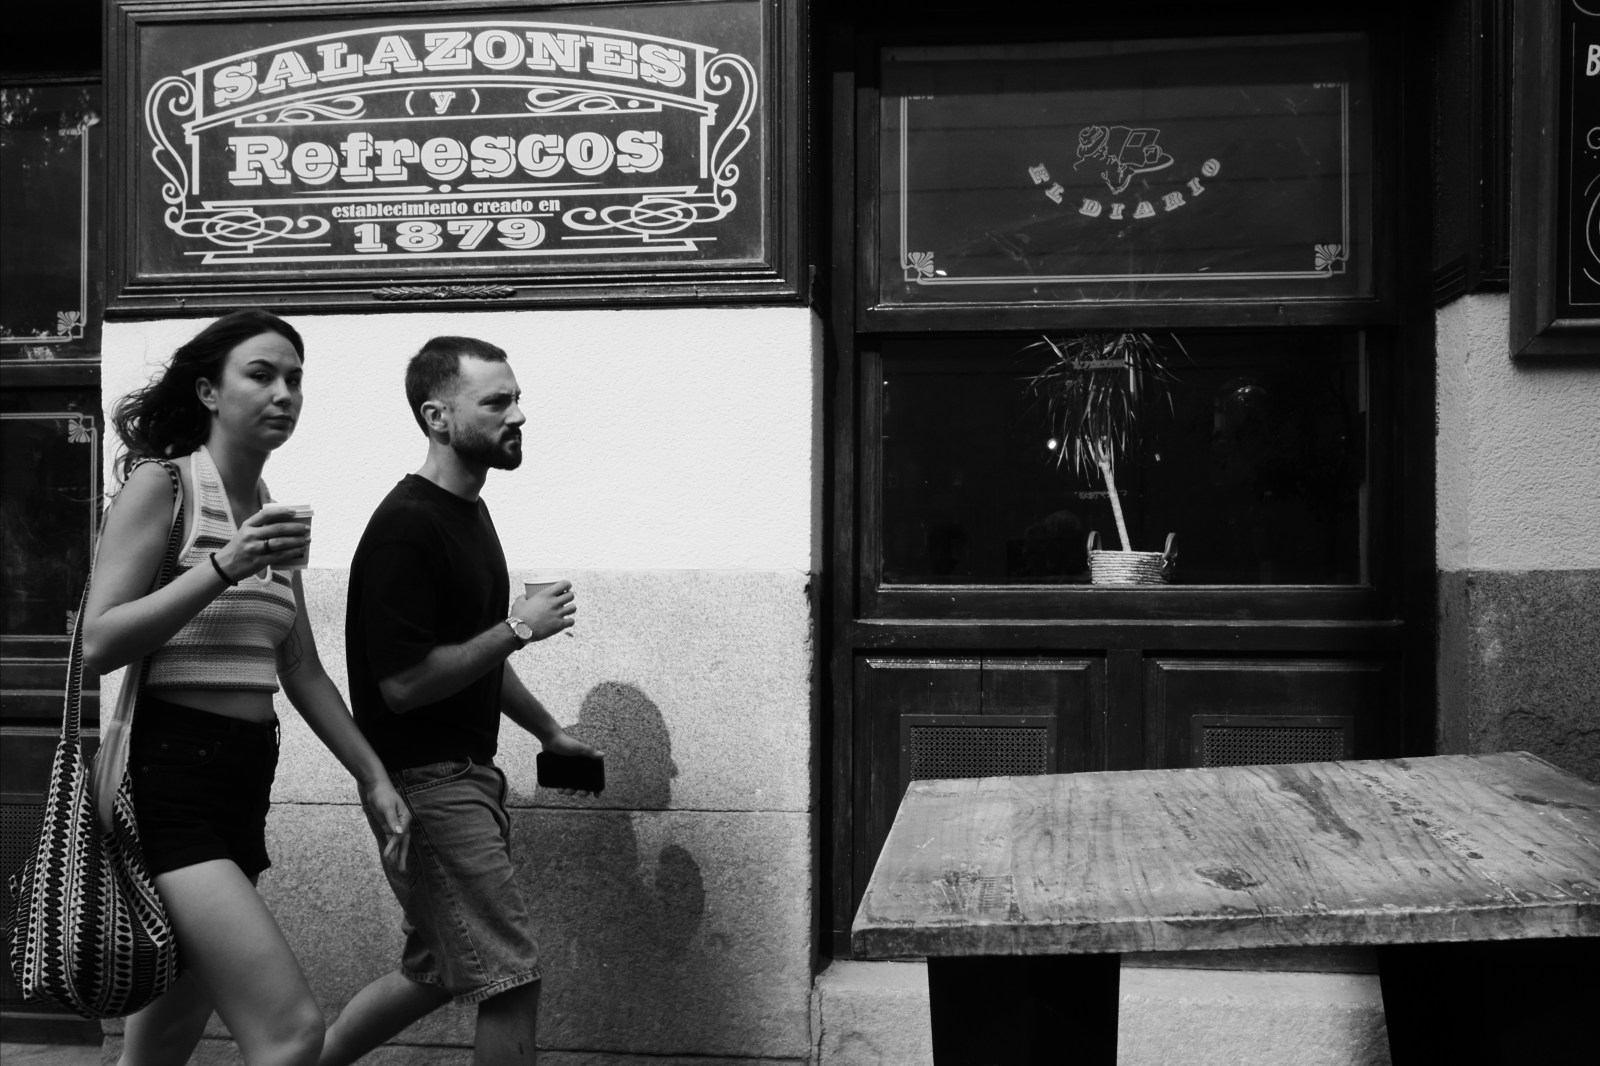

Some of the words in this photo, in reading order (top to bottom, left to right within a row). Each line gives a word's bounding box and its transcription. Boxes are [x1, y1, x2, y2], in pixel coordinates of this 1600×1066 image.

[213, 29, 686, 107] SALAZONES
[228, 130, 664, 186] Refrescos
[331, 201, 468, 218] establecimiento
[473, 199, 533, 213] creado
[538, 199, 561, 212] en
[1028, 163, 1064, 204] EL
[1079, 158, 1221, 219] DIARIO
[354, 218, 546, 252] 1879
